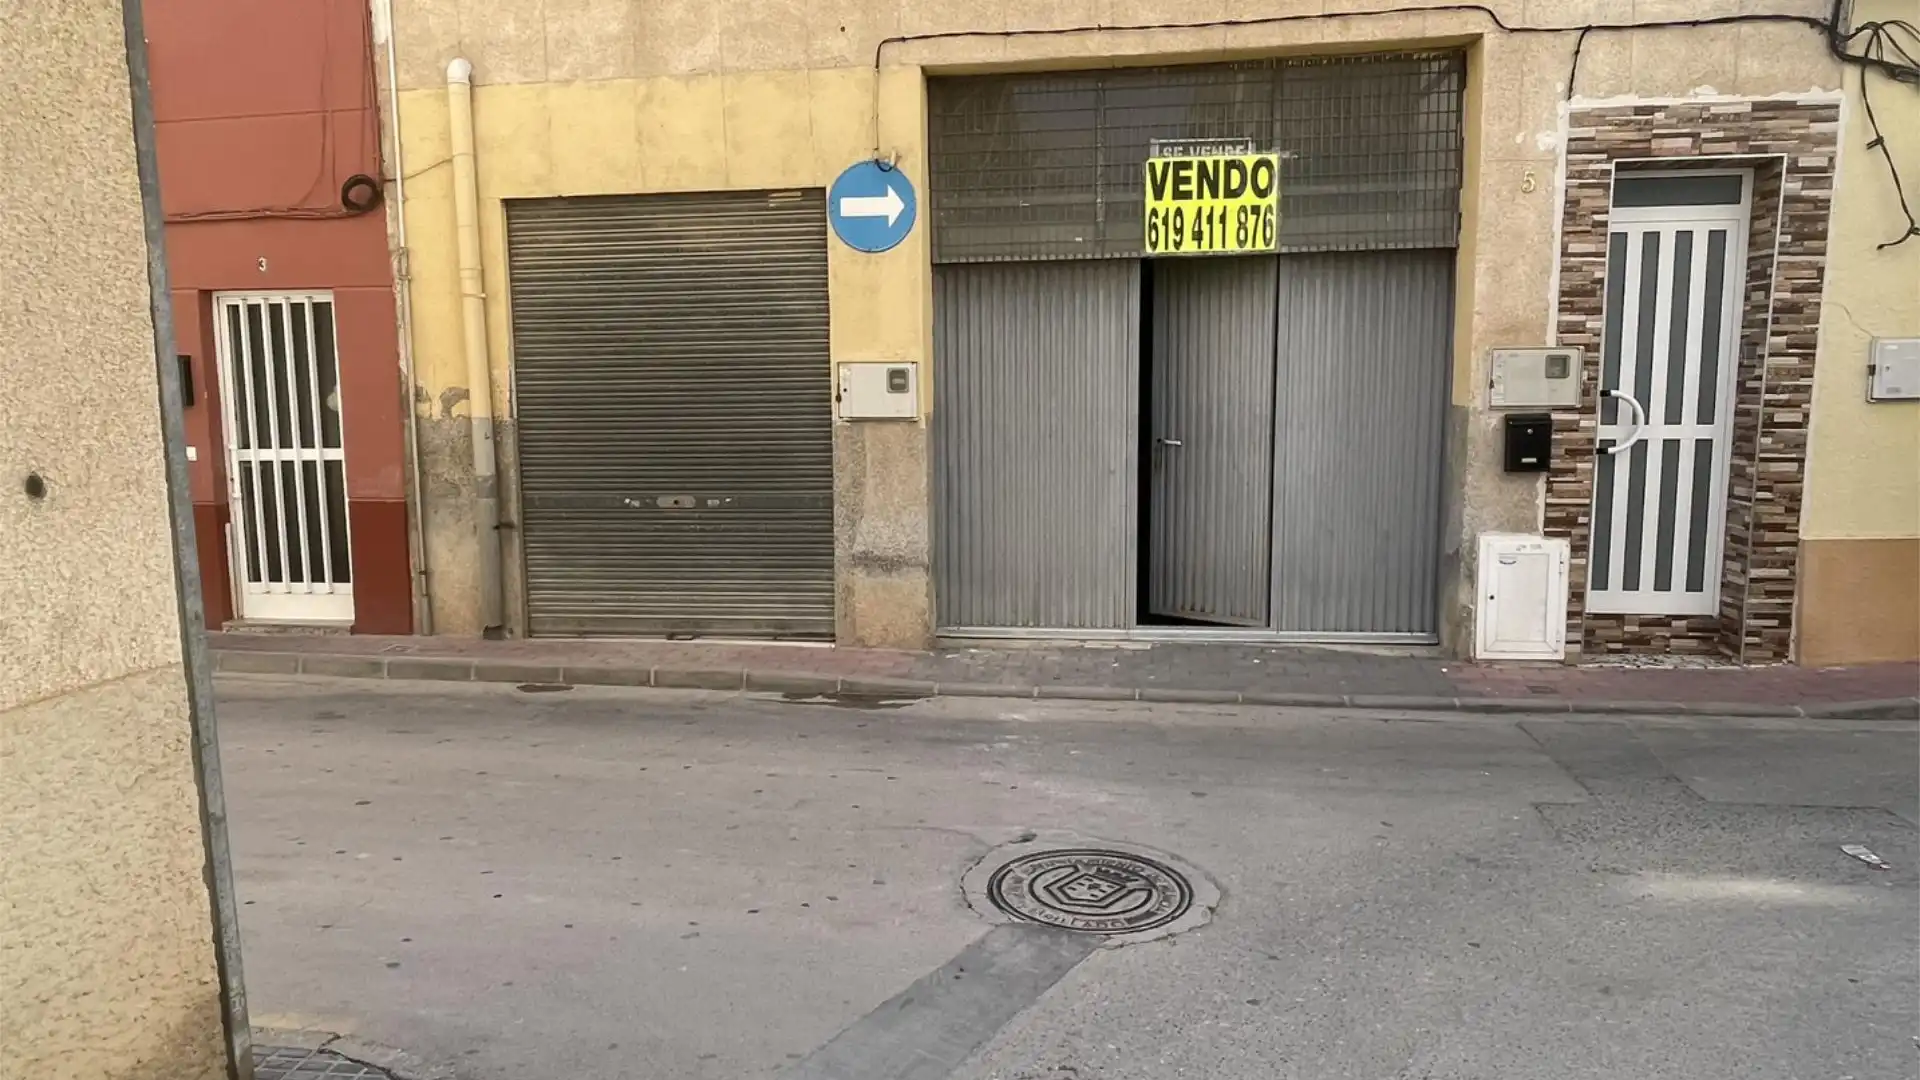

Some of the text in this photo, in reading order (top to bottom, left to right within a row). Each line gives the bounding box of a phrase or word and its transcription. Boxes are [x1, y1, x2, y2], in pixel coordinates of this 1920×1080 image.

[1148, 157, 1276, 201] VENDO
[1521, 171, 1536, 194] 5
[1148, 203, 1274, 251] 619 411 876
[257, 256, 267, 272] 3
